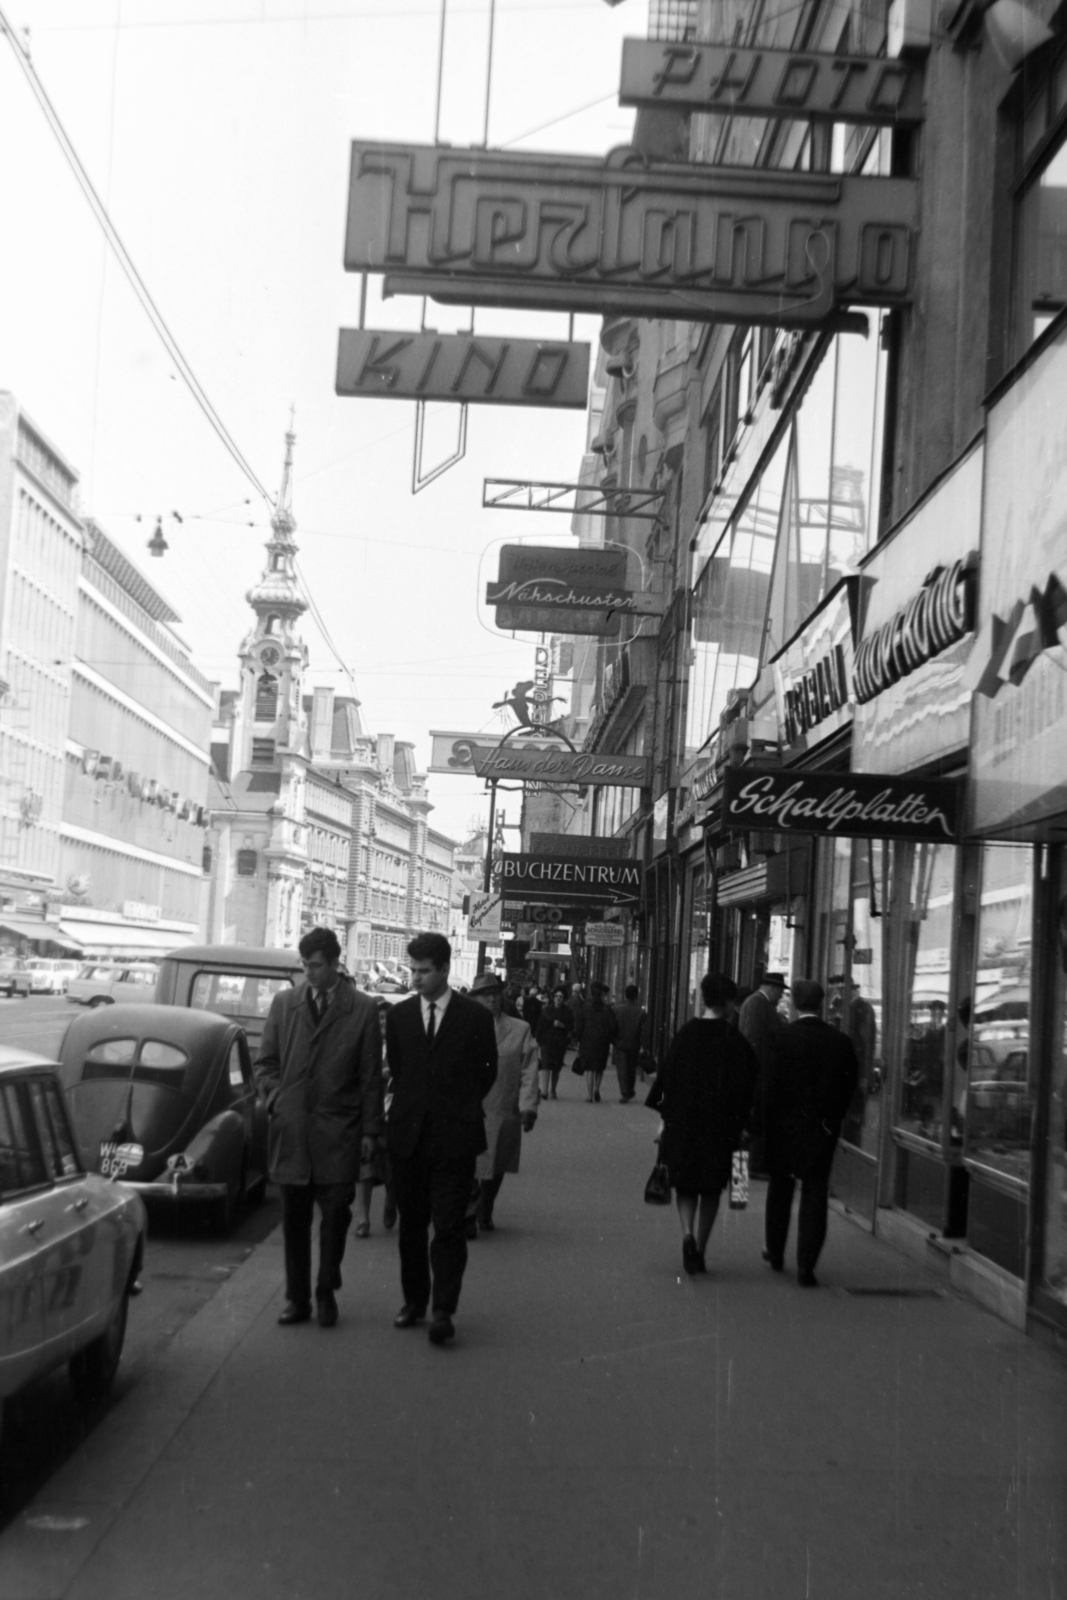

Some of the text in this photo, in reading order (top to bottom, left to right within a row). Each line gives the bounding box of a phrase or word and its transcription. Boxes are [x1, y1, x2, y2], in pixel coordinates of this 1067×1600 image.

[653, 47, 911, 110] PHOTO
[354, 336, 570, 396] KINO
[489, 578, 637, 609] Nähschuster
[533, 751, 570, 774] der
[570, 753, 646, 781] Dame
[730, 776, 956, 837] Schallplatten
[504, 860, 640, 885] BUCHZENTRUM
[175, 1155, 188, 1170] A
